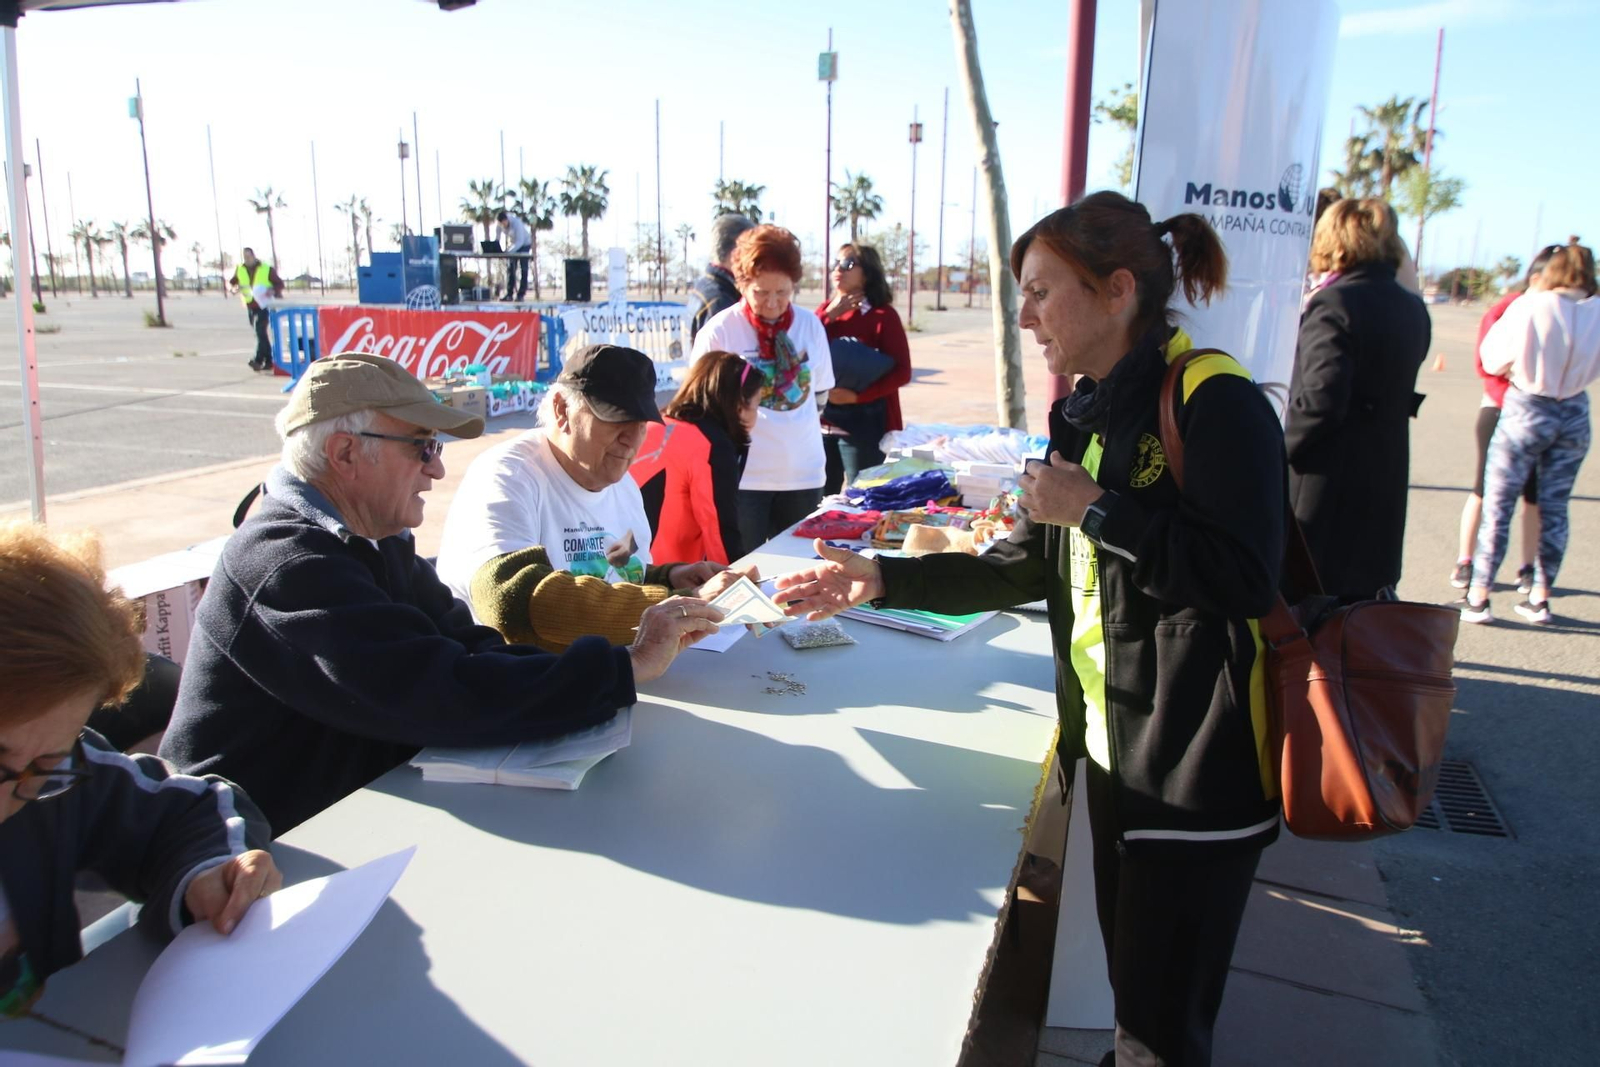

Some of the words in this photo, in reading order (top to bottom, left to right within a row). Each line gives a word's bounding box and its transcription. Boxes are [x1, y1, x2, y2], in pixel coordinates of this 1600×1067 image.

[1184, 182, 1276, 210] Manos
[1201, 212, 1266, 234] MPAÑA
[582, 306, 623, 333] Scouts
[564, 536, 604, 552] COMARTE
[573, 552, 587, 562] QUE
[155, 593, 171, 634] Kappa
[157, 637, 171, 659] rfit
